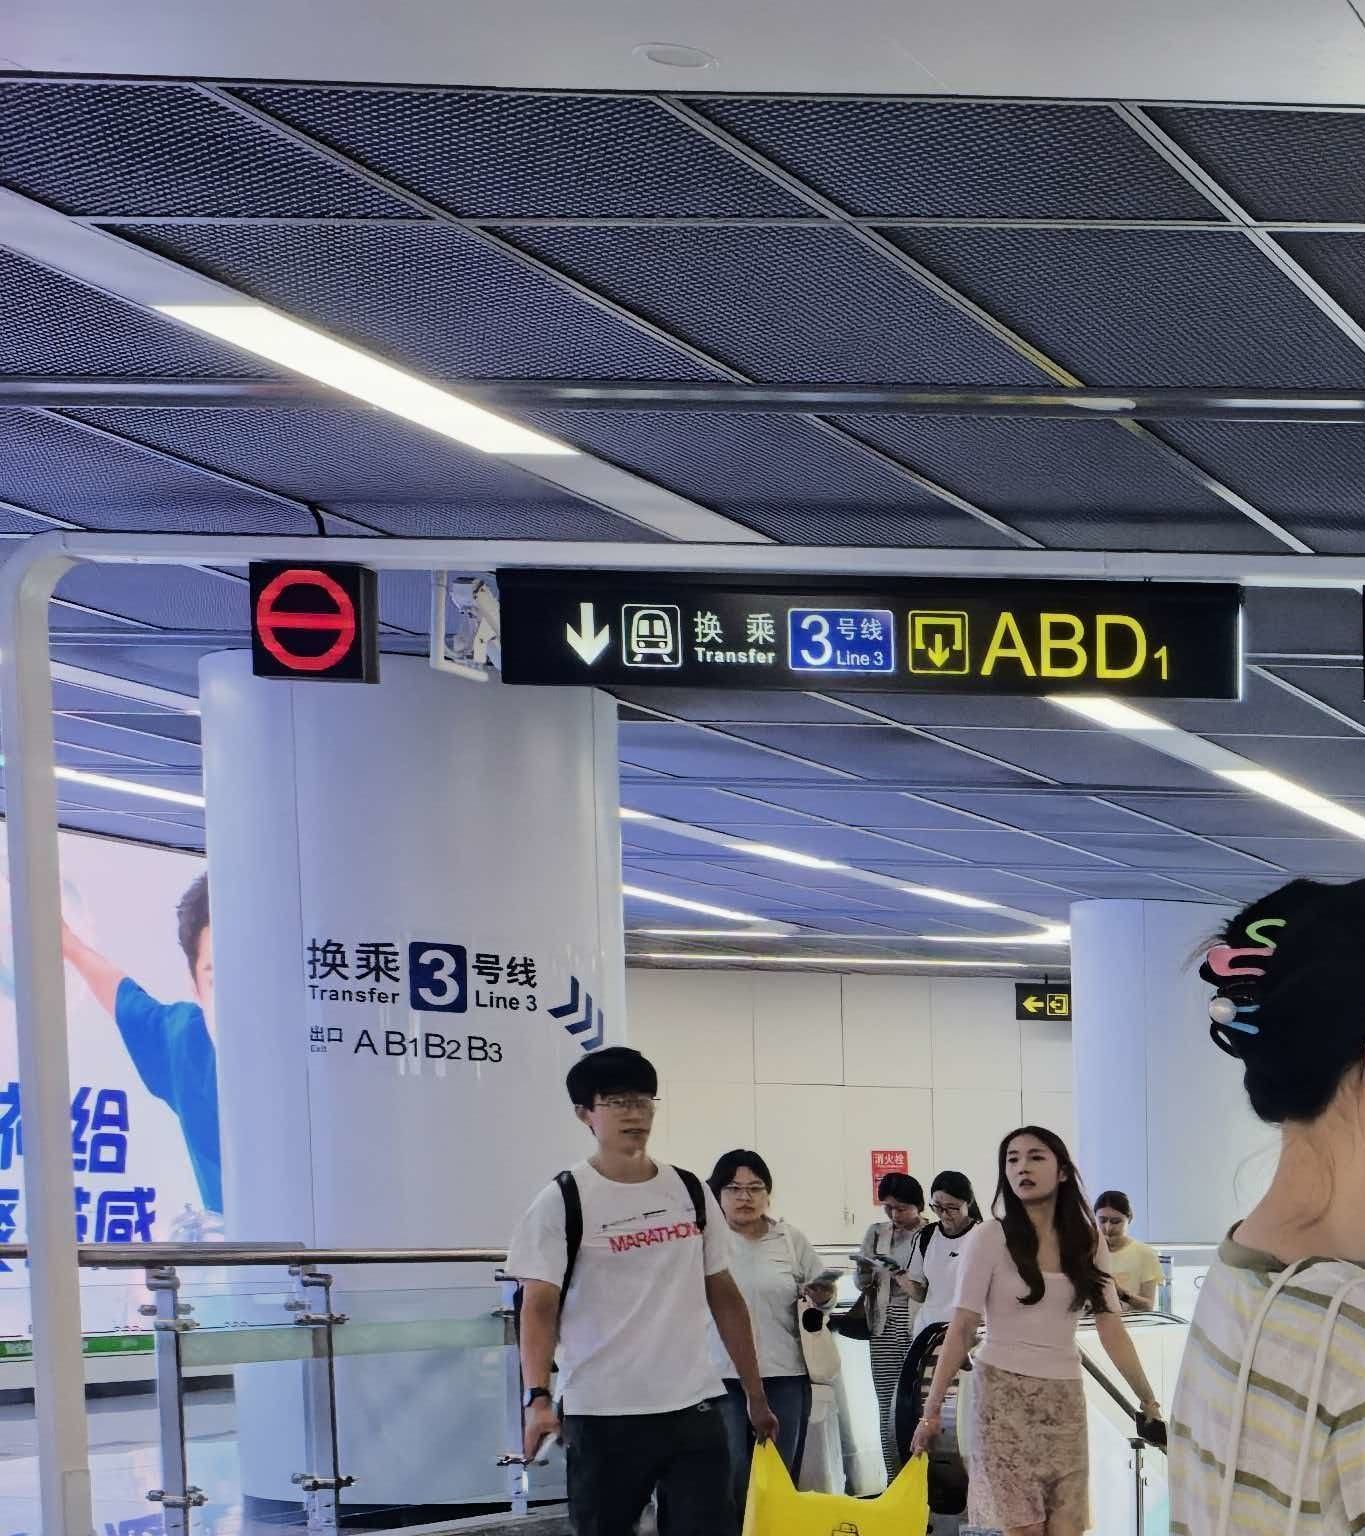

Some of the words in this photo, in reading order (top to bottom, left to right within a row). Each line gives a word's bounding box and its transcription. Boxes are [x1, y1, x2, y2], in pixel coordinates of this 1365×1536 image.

[694, 610, 776, 644] 换乘
[800, 614, 830, 666] 3
[836, 618, 883, 641] 号线
[694, 647, 776, 664] Transfer
[836, 650, 869, 666] Line
[874, 651, 884, 666] 3
[307, 938, 400, 982] 换乘
[418, 949, 460, 1006] 3
[472, 953, 538, 988] 号线
[308, 985, 400, 1004] Transfer
[475, 990, 520, 1010] Line
[526, 994, 538, 1012] 3
[310, 1025, 343, 1042] 出口
